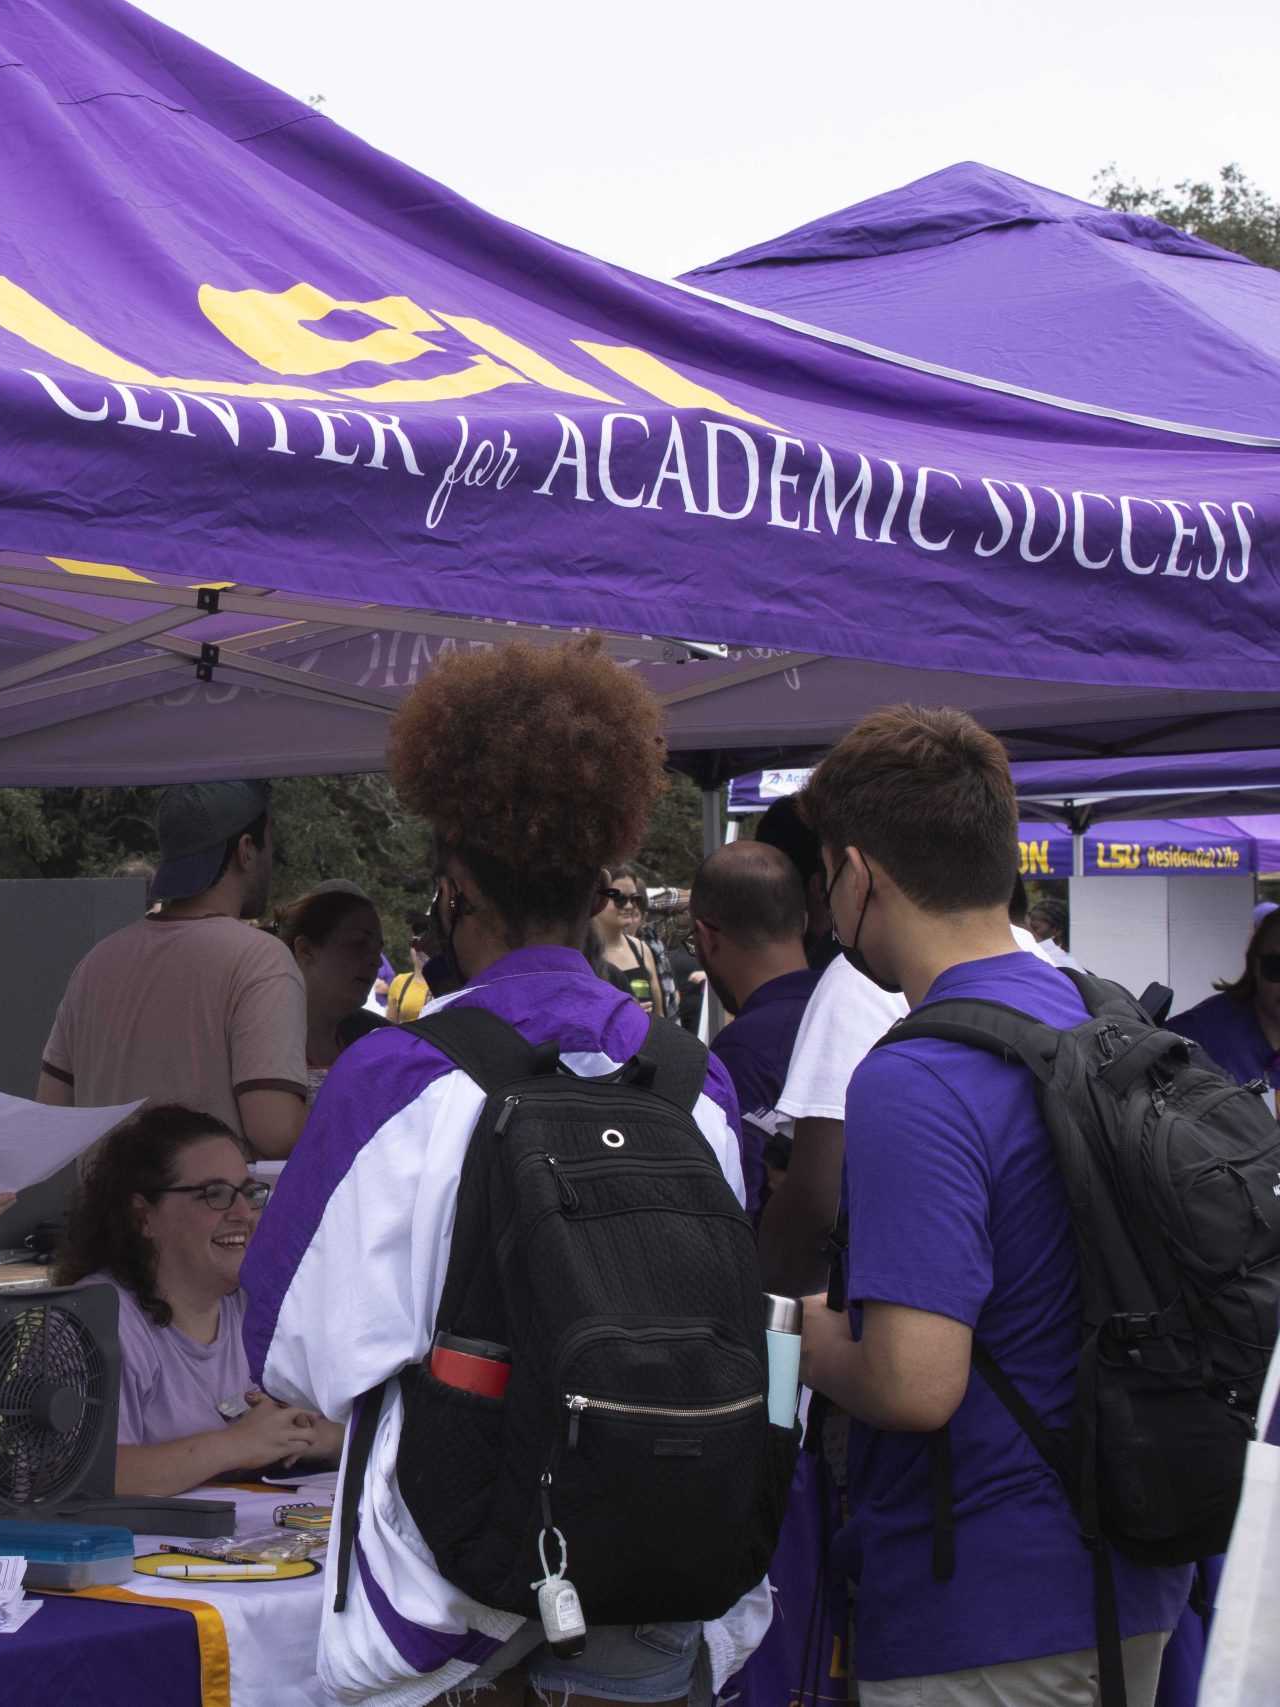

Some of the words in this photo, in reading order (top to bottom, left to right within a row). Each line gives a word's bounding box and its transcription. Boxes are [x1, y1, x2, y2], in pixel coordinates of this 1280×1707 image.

[21, 368, 424, 477] CENTER
[425, 415, 519, 528] for
[533, 413, 962, 551] ACADEMIC
[974, 477, 1256, 583] SUCCESS
[1096, 842, 1140, 869] LSU
[1147, 847, 1214, 869] Residential
[1215, 846, 1240, 868] Life
